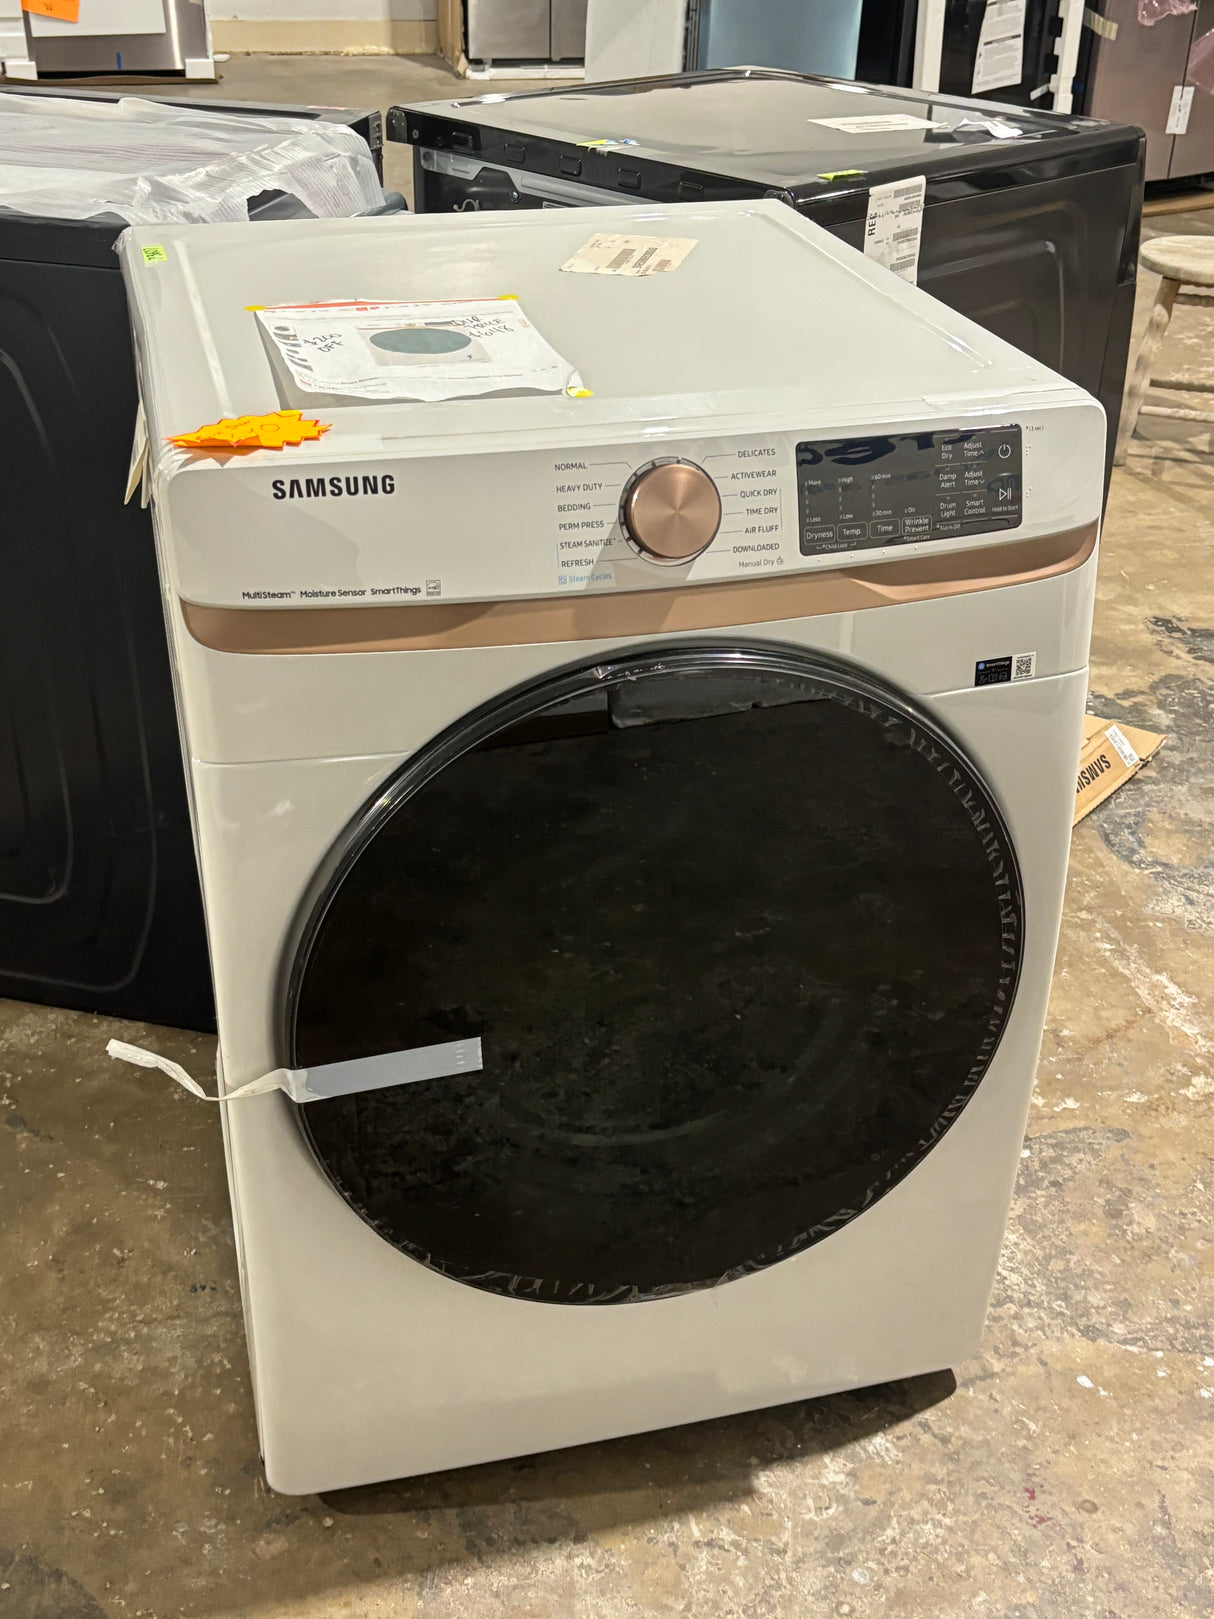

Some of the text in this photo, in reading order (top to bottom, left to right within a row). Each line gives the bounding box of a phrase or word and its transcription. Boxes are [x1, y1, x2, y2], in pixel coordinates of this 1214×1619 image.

[317, 340, 343, 353] OFF
[941, 443, 953, 452] Eco
[963, 441, 983, 451] Adjust
[737, 448, 776, 458] DELICATES
[941, 452, 953, 461] Dry
[963, 450, 978, 458] Time
[554, 462, 587, 471] NORMAL
[731, 470, 777, 480] ACTIVEWEAR
[841, 476, 854, 484] High
[939, 472, 957, 483] Damp
[964, 471, 984, 481] Adjust
[272, 475, 395, 500] SAMSUNG
[556, 482, 603, 493] HEAVY DUTY
[940, 481, 956, 489] Alert
[964, 479, 979, 487] Time
[740, 488, 778, 498] QUICK DRY
[557, 503, 591, 512] BEDDING
[940, 501, 957, 511] Drum
[965, 498, 985, 507] Smart
[764, 506, 779, 514] DRY
[907, 506, 916, 514] On
[940, 509, 957, 519] Light
[963, 506, 986, 516] Control
[559, 520, 604, 530] PERM PRESS
[904, 517, 930, 525] Wrinkle
[744, 525, 780, 534] AIR FLUFF
[842, 527, 862, 537] Temp.
[876, 523, 894, 533] Time
[904, 525, 930, 534] Prevent
[806, 530, 834, 541] Dryness
[560, 541, 583, 549] STEAM
[732, 542, 780, 553] DOWNLOADED
[561, 559, 594, 568] REFRESH
[738, 558, 775, 568] Manual Dry
[568, 573, 612, 583] Steam Cycles
[300, 586, 367, 599] Moisture Sensor
[370, 585, 422, 597] SmartThings
